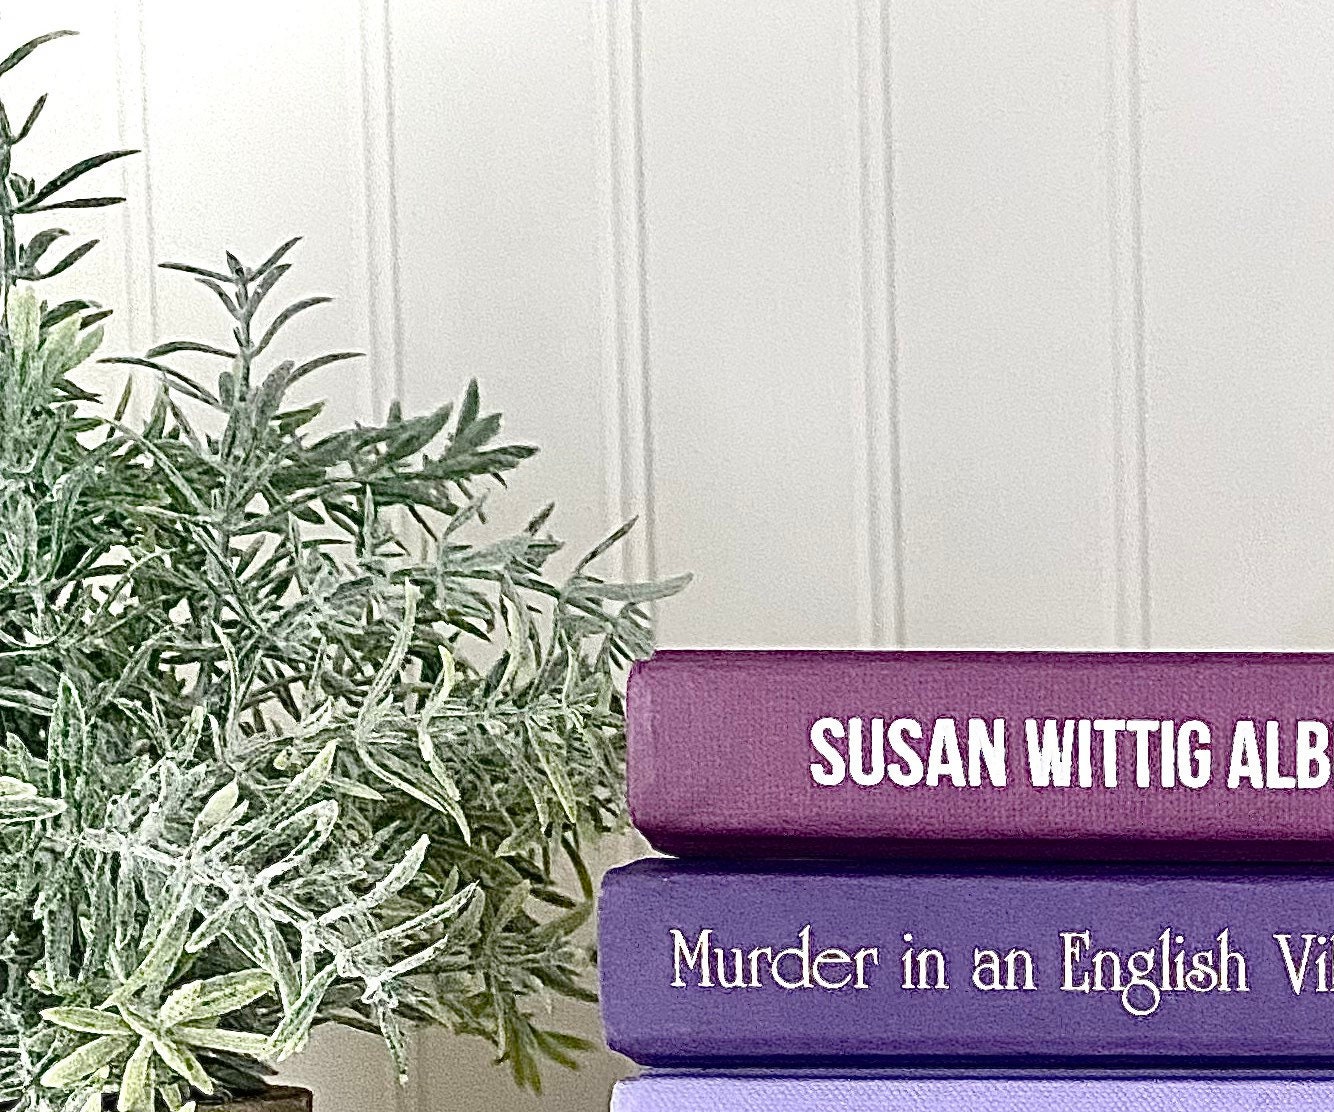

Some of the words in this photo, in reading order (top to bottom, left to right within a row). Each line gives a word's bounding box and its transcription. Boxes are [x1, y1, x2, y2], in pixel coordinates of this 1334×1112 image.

[811, 718, 1006, 787] SUSAN
[1025, 718, 1211, 789] WITTIG
[669, 925, 879, 989] Murder
[901, 933, 950, 990] in
[972, 947, 1038, 991] an
[1059, 928, 1250, 1016] English
